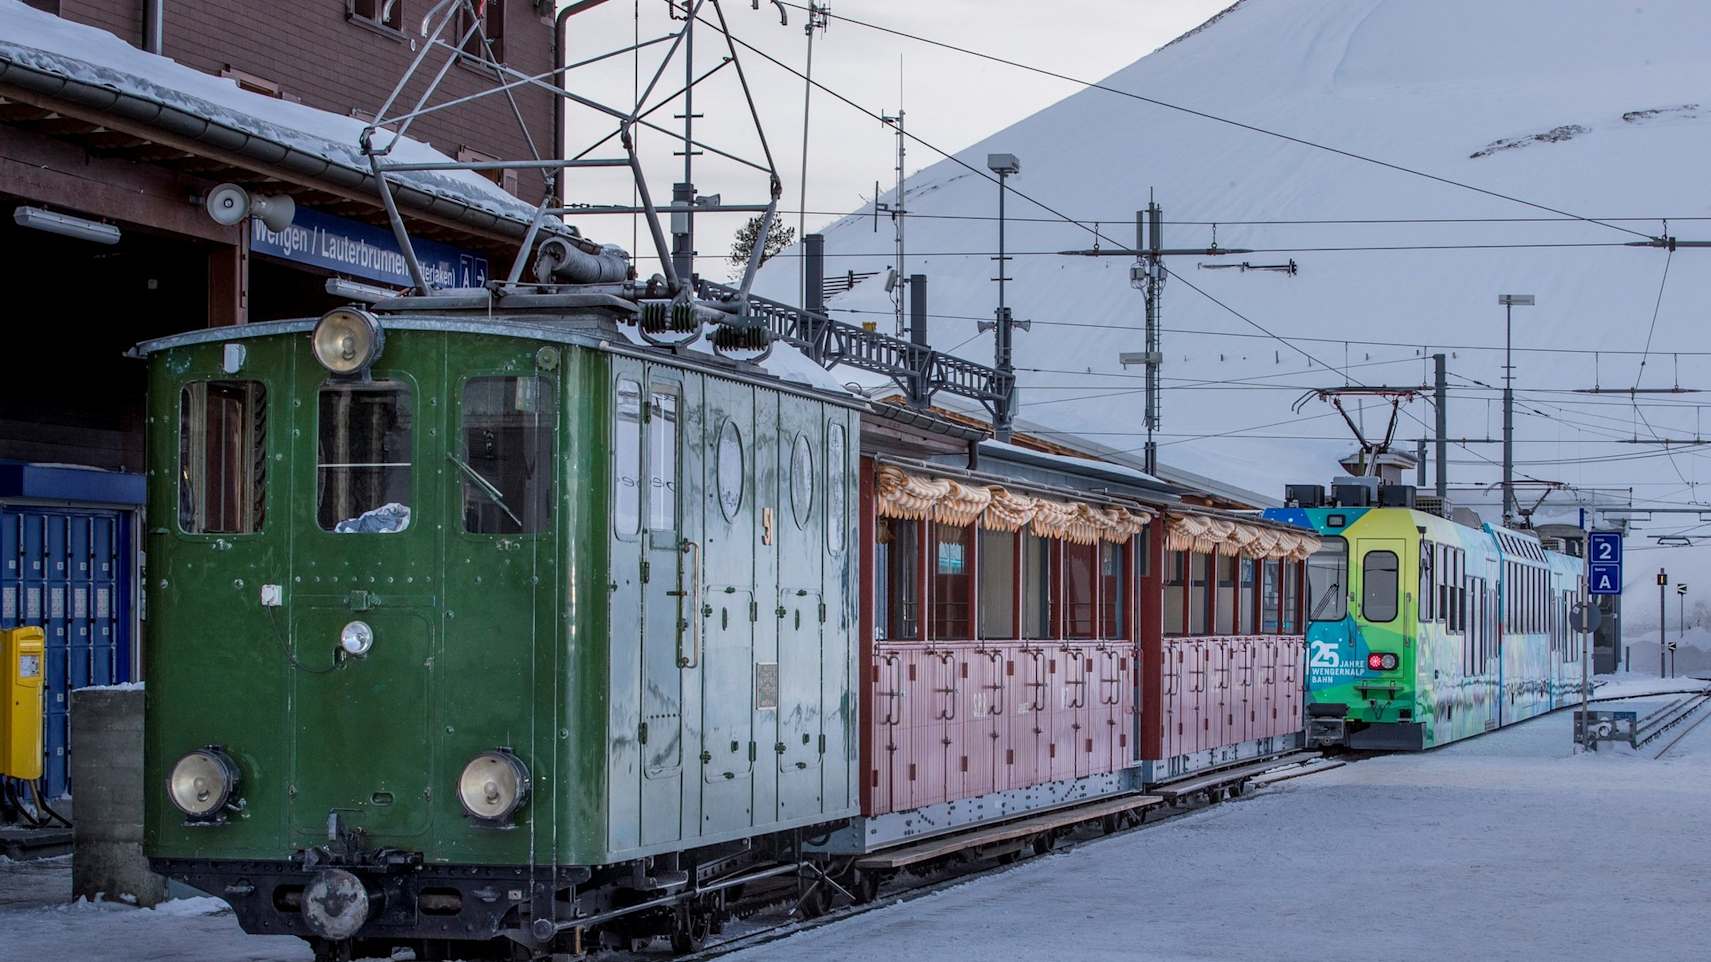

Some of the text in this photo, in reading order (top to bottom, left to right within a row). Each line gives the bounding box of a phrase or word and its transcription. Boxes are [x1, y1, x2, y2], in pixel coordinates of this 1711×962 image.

[255, 219, 308, 256] Wengen
[311, 225, 318, 255] /
[321, 228, 409, 277] Lauterbrunnen
[462, 267, 470, 288] A
[1599, 543, 1612, 559] 2
[1599, 575, 1612, 589] A
[1340, 660, 1365, 668] JAHRE
[1312, 668, 1366, 676] WENGERNALP
